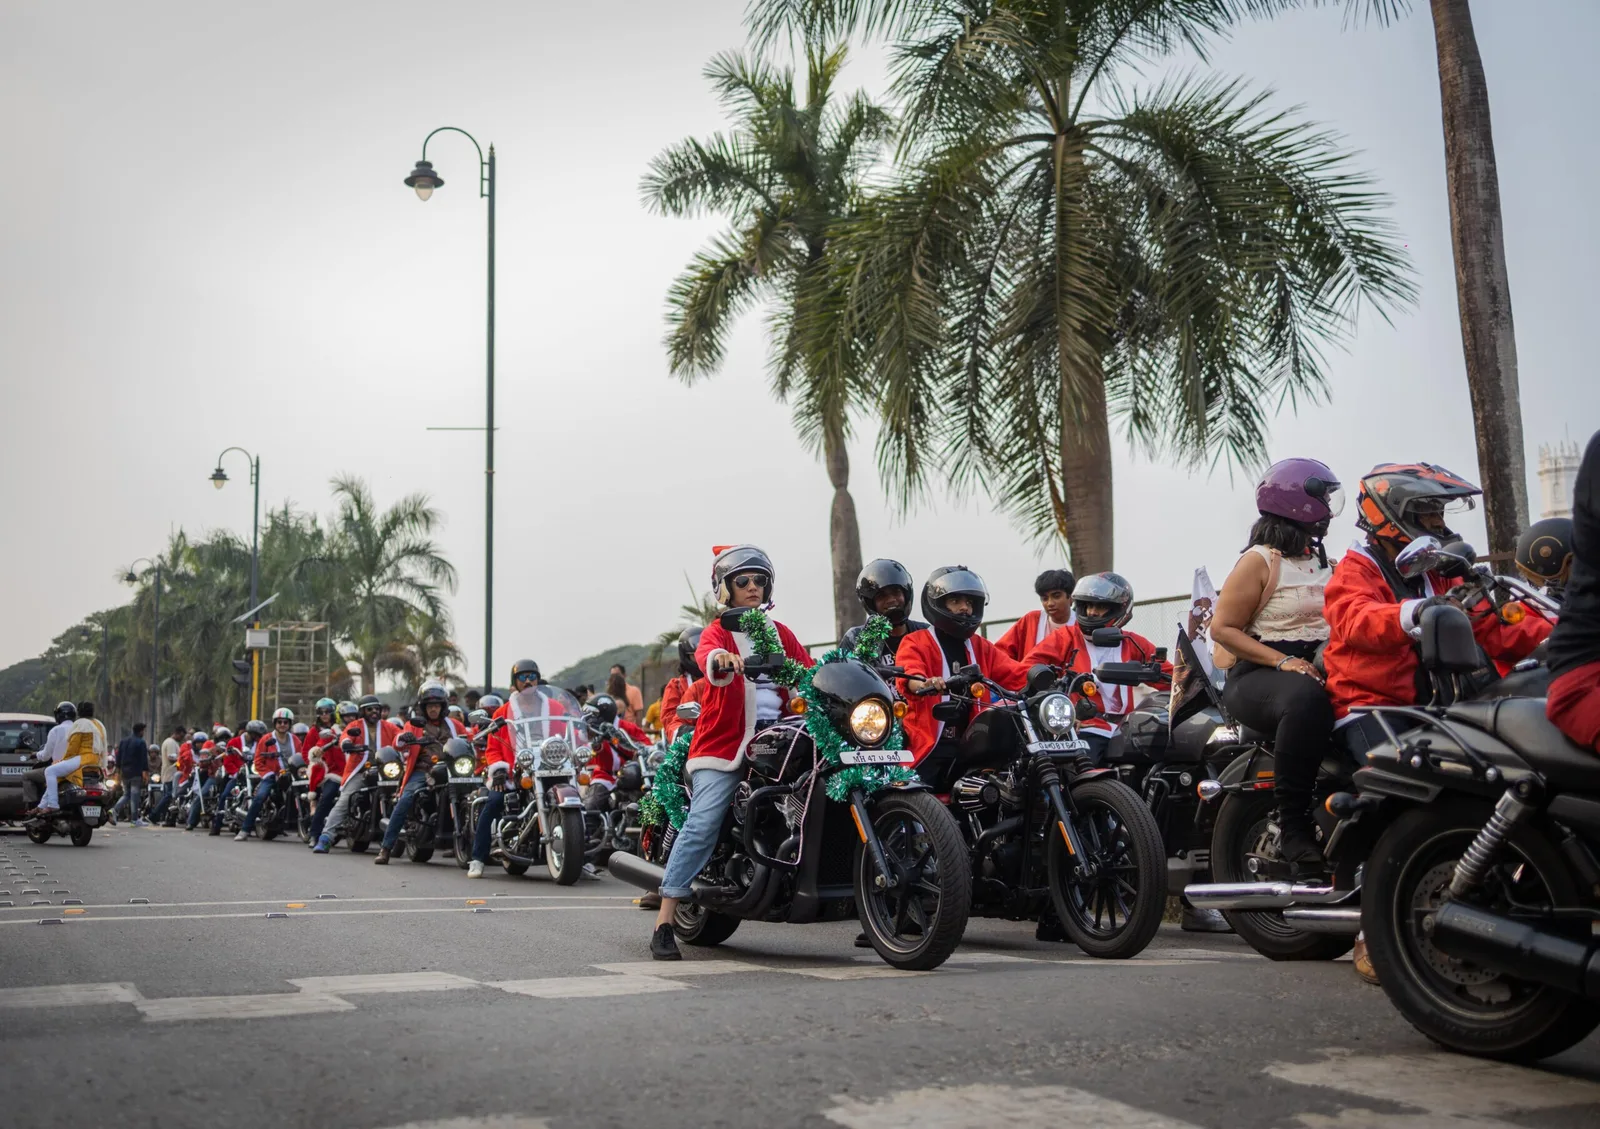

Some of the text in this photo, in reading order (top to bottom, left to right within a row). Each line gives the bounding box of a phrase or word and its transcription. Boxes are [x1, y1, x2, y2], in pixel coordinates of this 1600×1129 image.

[853, 755, 866, 763] MH
[867, 754, 876, 762] 47
[886, 753, 901, 762] 940
